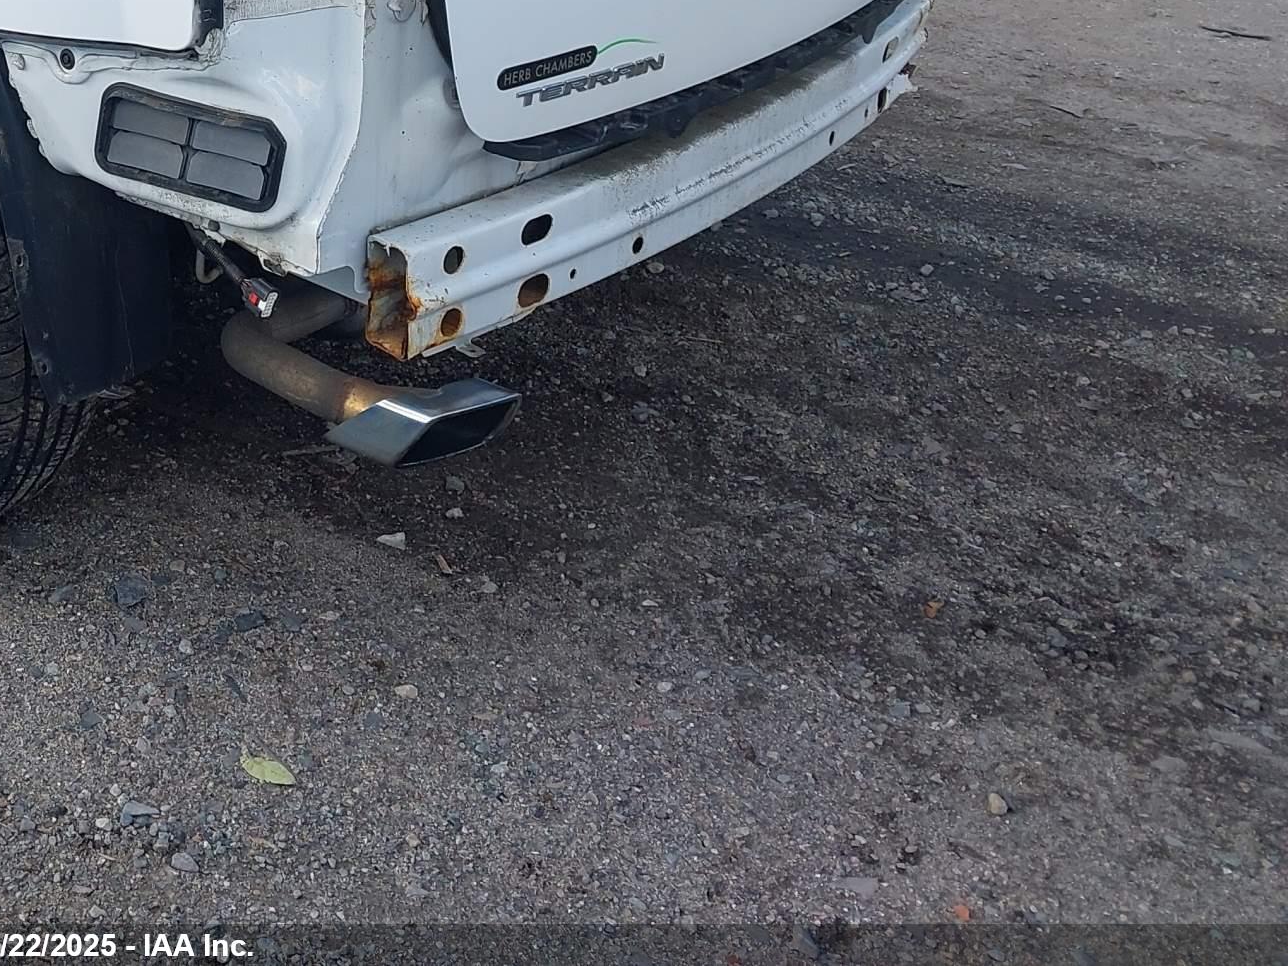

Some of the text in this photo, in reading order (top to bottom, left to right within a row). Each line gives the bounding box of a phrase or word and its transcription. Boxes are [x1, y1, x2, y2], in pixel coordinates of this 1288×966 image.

[503, 50, 593, 87] HERB CHAMBERS
[515, 52, 665, 108] TERRAIN
